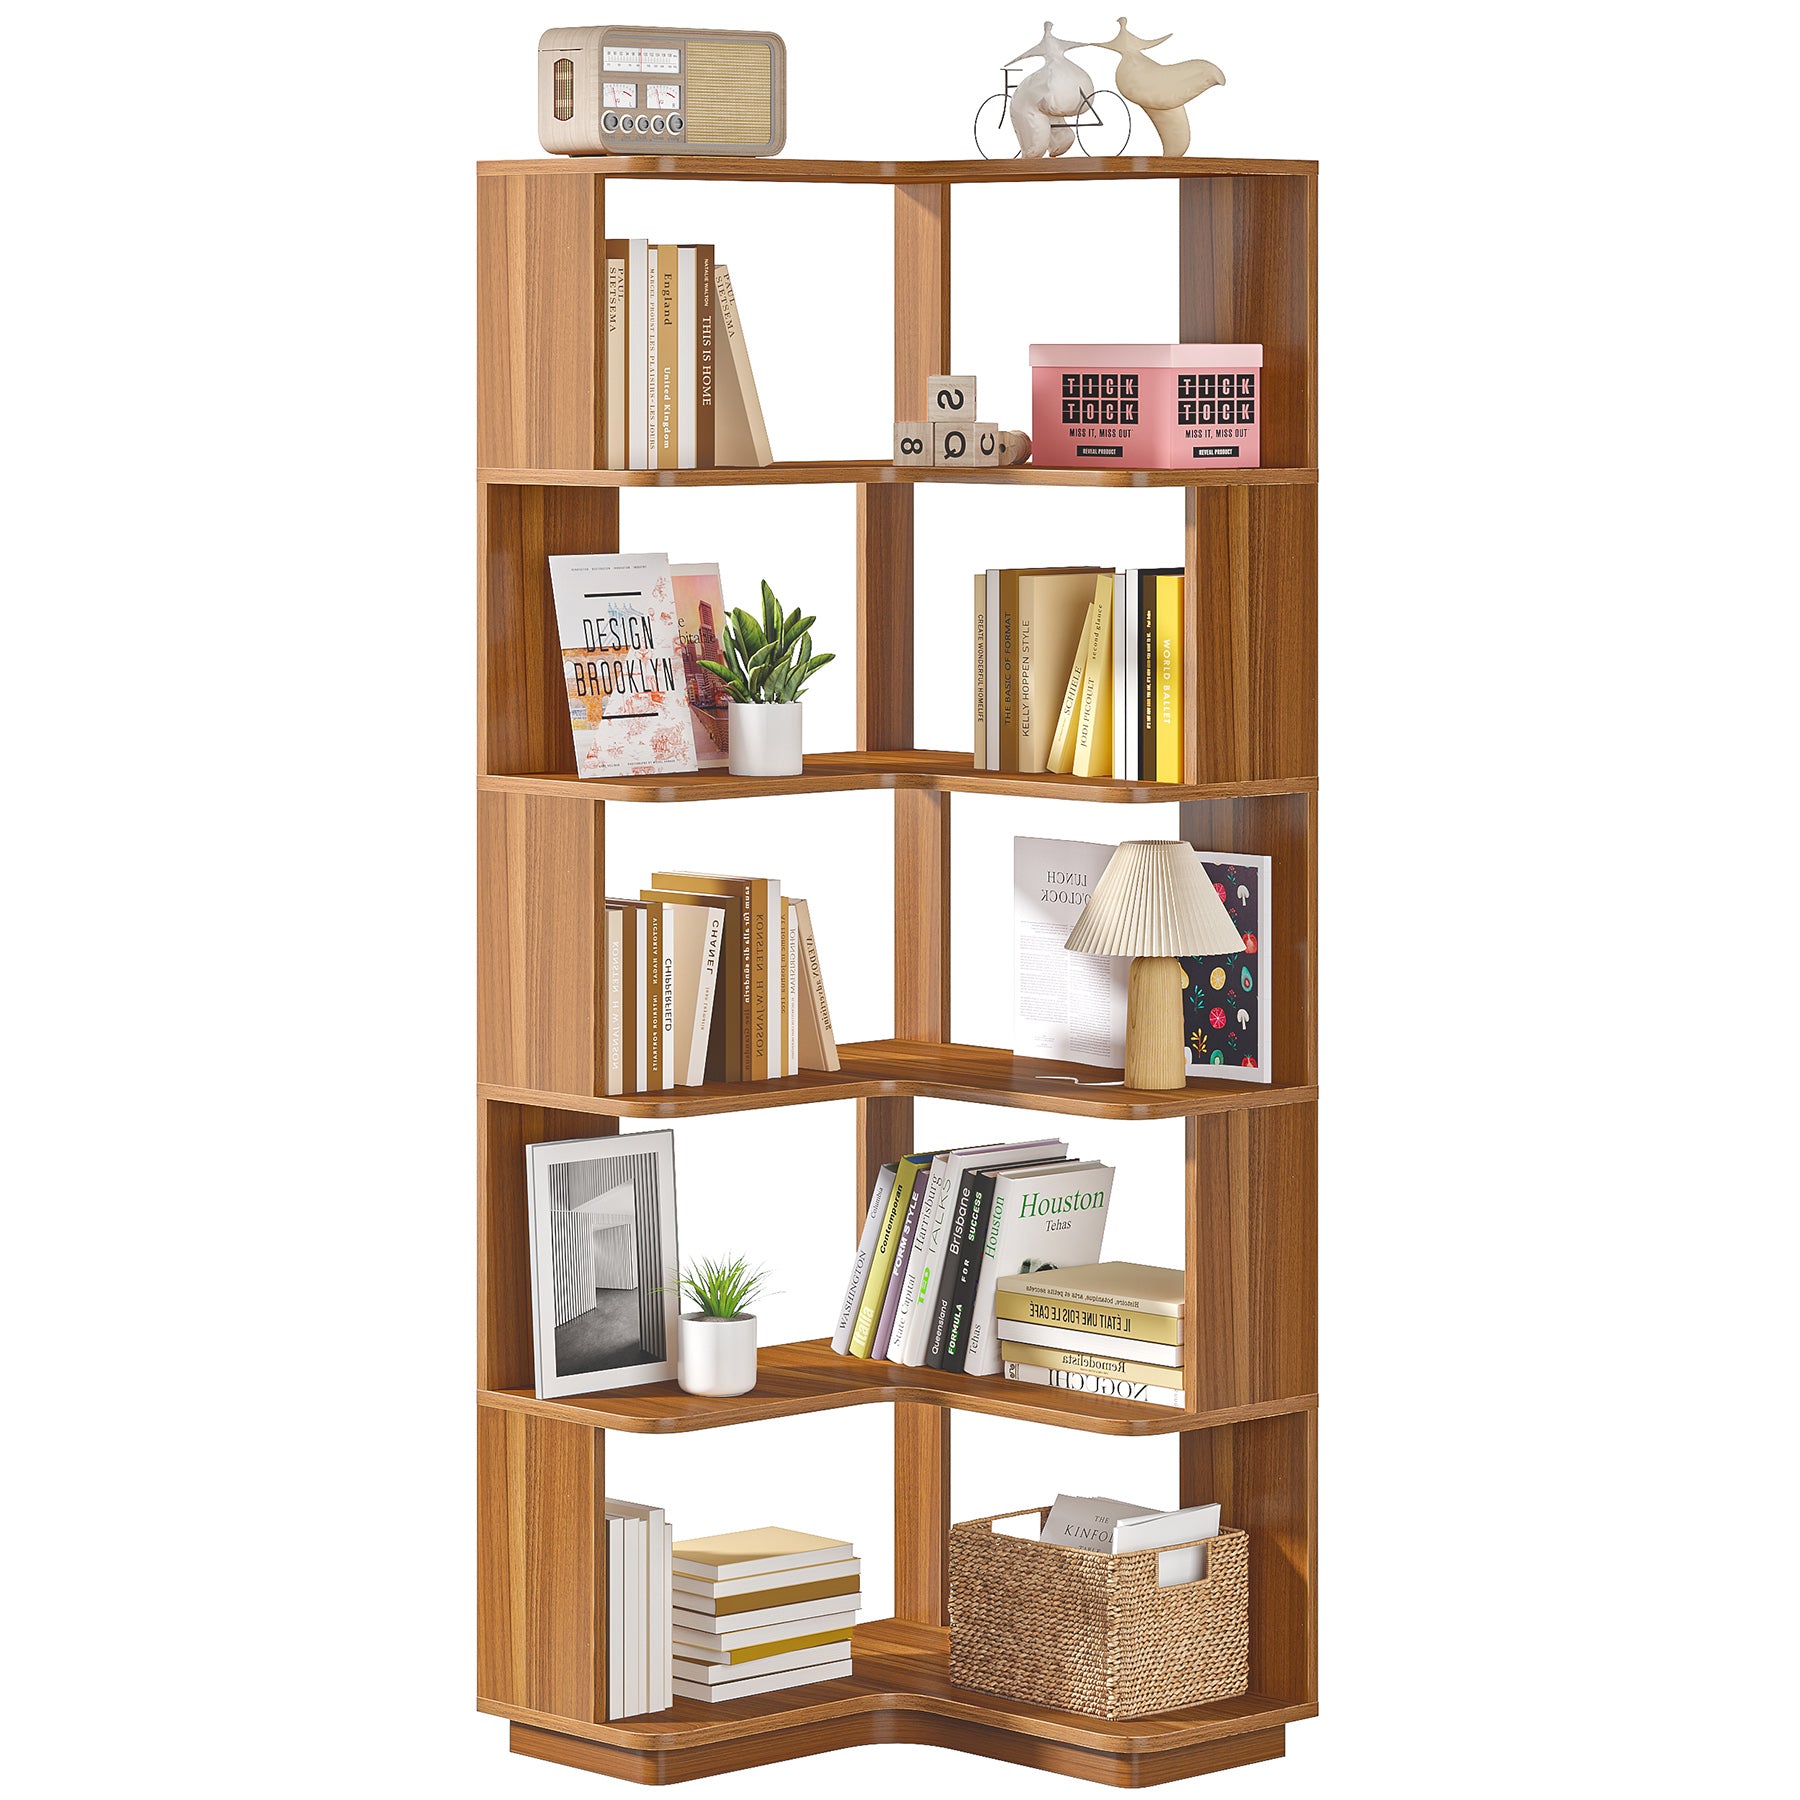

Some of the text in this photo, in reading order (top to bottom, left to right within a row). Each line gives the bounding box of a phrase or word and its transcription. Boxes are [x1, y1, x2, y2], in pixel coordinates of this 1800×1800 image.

[662, 273, 672, 326] England
[716, 276, 736, 338] SIETSEMA
[722, 273, 735, 305] PAUL
[702, 316, 712, 346] THIS
[702, 350, 712, 362] IS
[702, 365, 712, 406] HOME
[1066, 376, 1135, 396] TICK
[1182, 376, 1252, 396] TICK
[661, 404, 672, 448] Kingdom
[1066, 402, 1135, 421] TOCK
[1182, 402, 1252, 421] TOCK
[901, 437, 923, 454] 8
[1070, 428, 1132, 438] MISS IT, MISS OUT
[1185, 428, 1248, 439] MISS IT, MISS OUT
[582, 616, 654, 652] DESIGN
[574, 658, 675, 696] BROOKLYN
[1005, 658, 1011, 671] OF
[1081, 604, 1103, 747] JODI PICOULT second glance
[1064, 666, 1082, 715] SCHIELE
[1018, 1190, 1104, 1218] Houston
[893, 1191, 919, 1276] FORM STYLE
[917, 1179, 951, 1305] TED TALKS
[1045, 1220, 1072, 1232] Tehas
[840, 1187, 884, 1329] WASHINGTON Columbia
[893, 1177, 942, 1347] State Capital Harrisburg
[931, 1188, 971, 1355] Queensland Brisbane
[948, 1303, 962, 1355] FORMULA
[968, 1192, 982, 1241] SUCCESS
[969, 1196, 1006, 1354] Tehas Houston
[854, 1306, 873, 1346] Italia
[1094, 1515, 1110, 1524] THE
